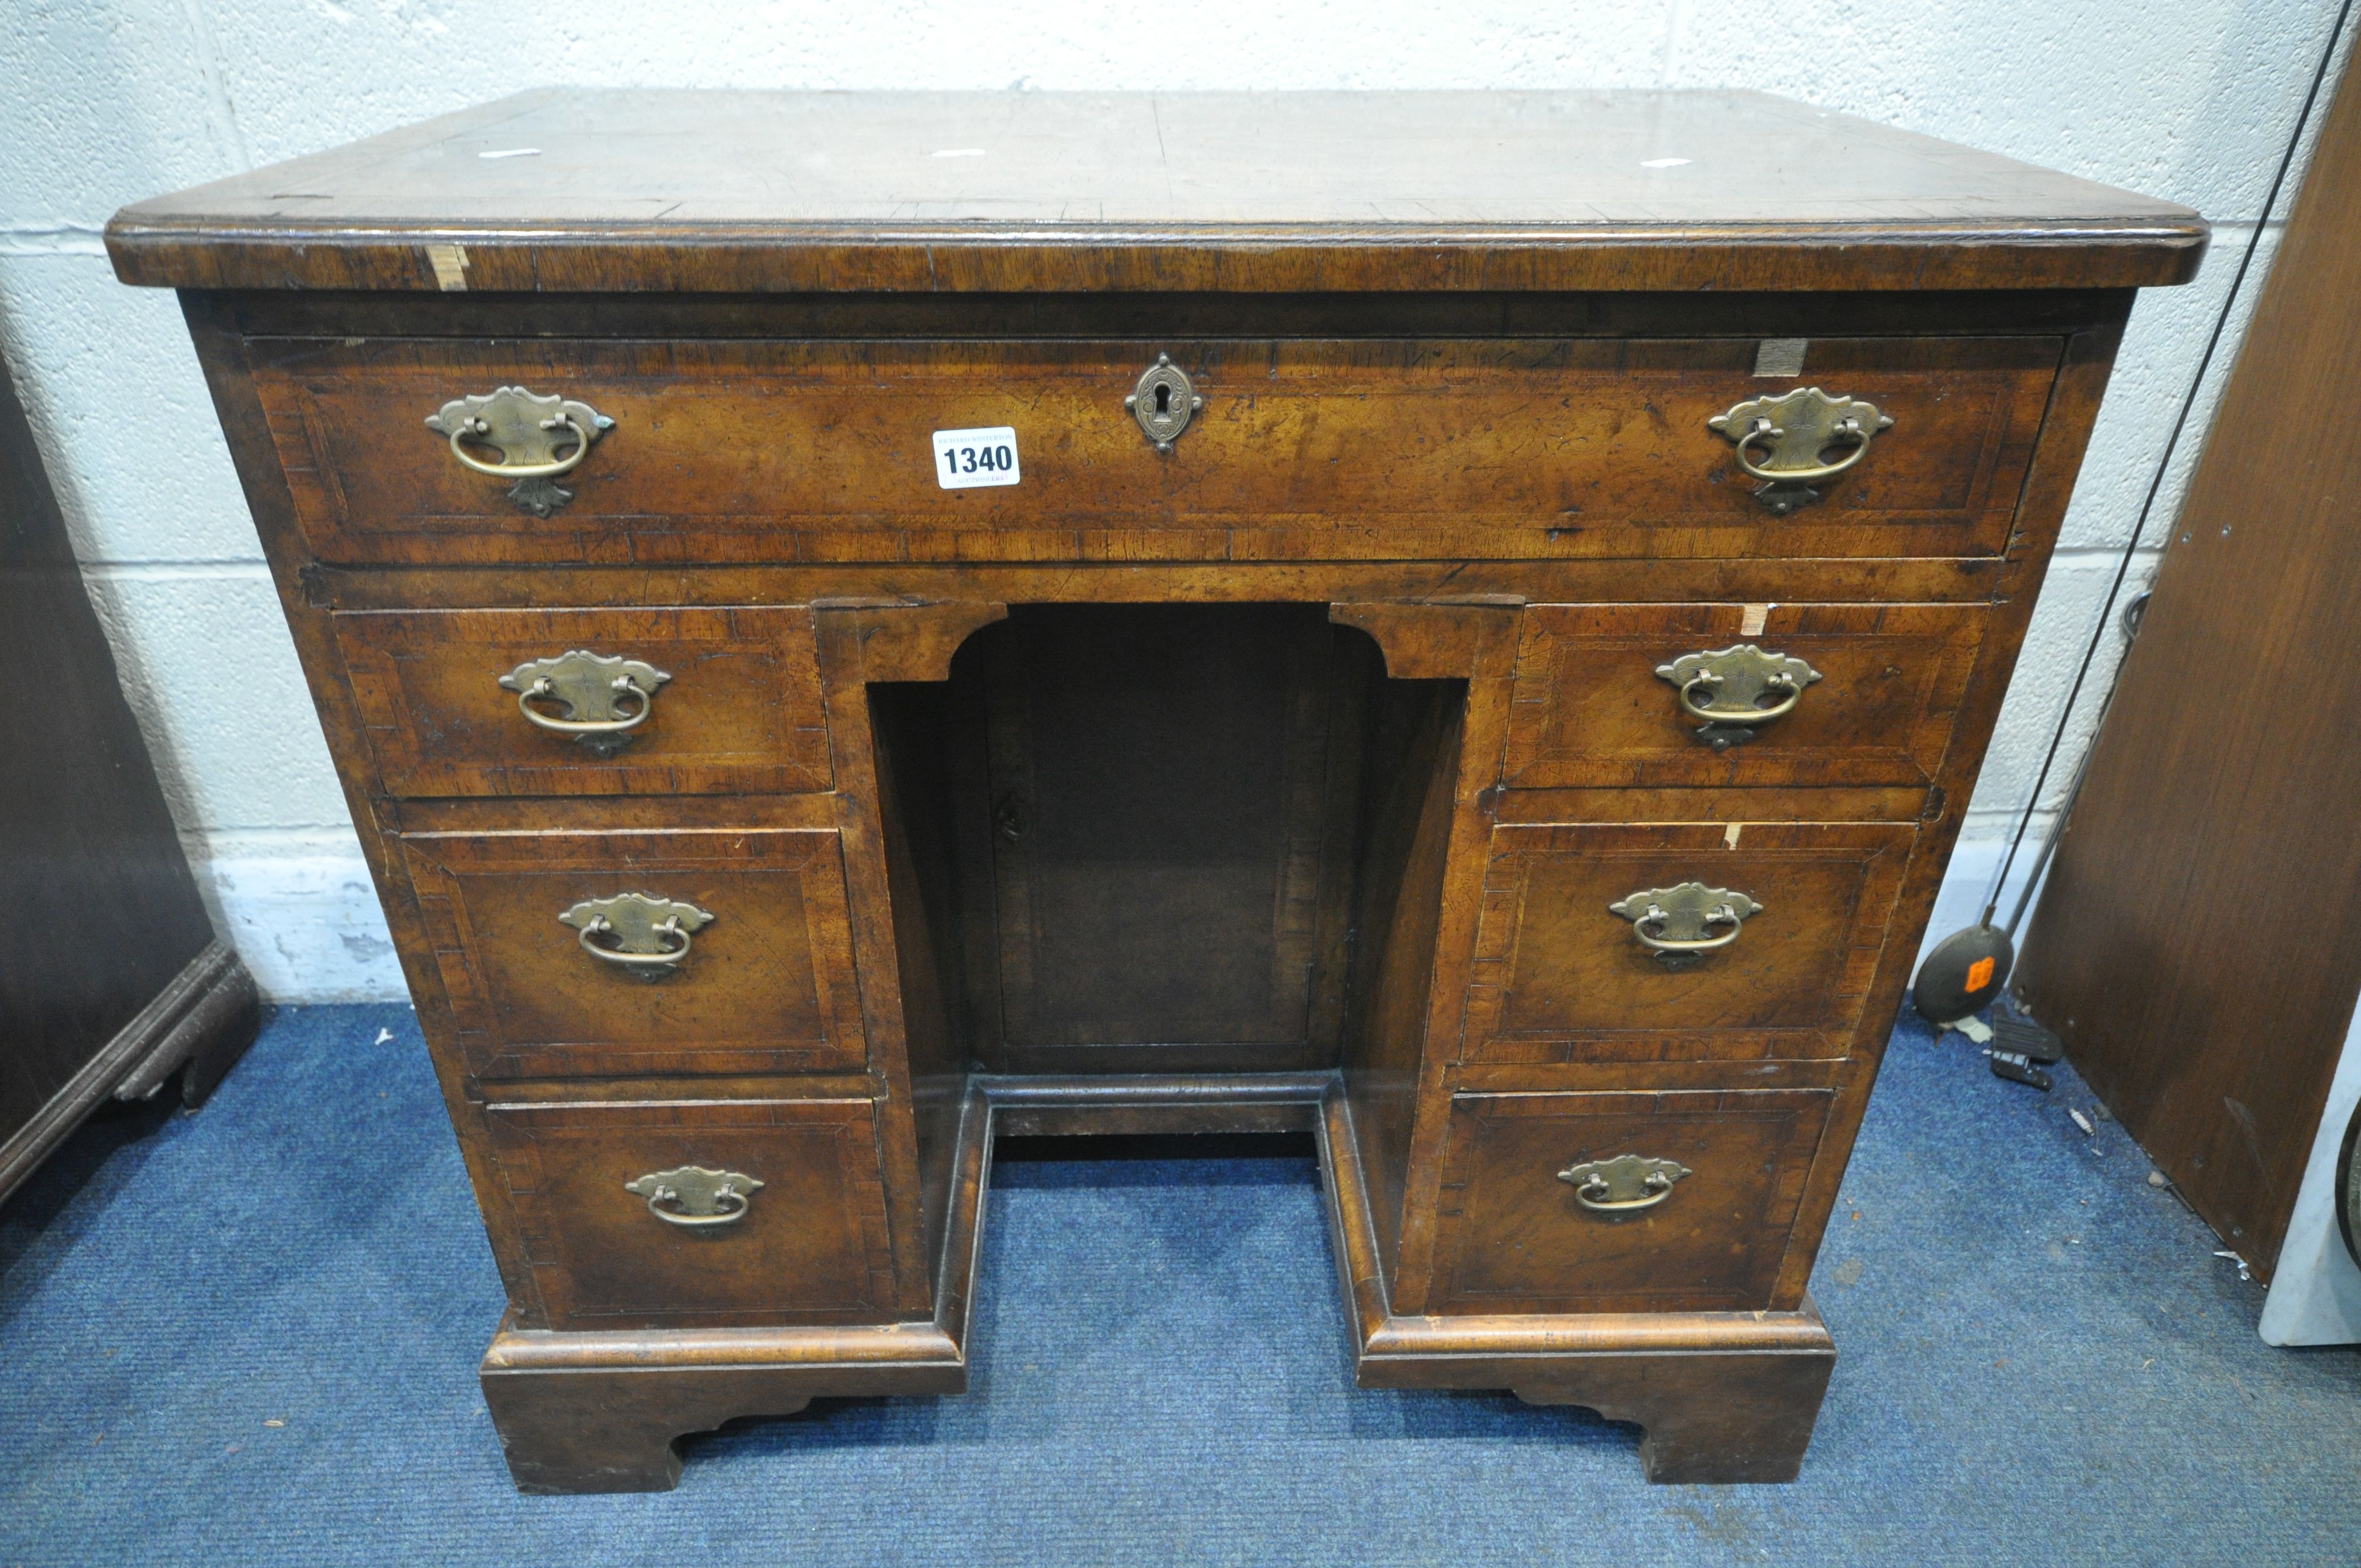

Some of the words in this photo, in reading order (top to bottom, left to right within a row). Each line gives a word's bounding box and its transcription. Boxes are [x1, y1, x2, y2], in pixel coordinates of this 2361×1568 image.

[938, 436, 970, 444] RICHARD
[972, 434, 1012, 442] WINTERTON
[944, 445, 1012, 473] 1340
[957, 476, 1004, 484] AUCTIONEERS
